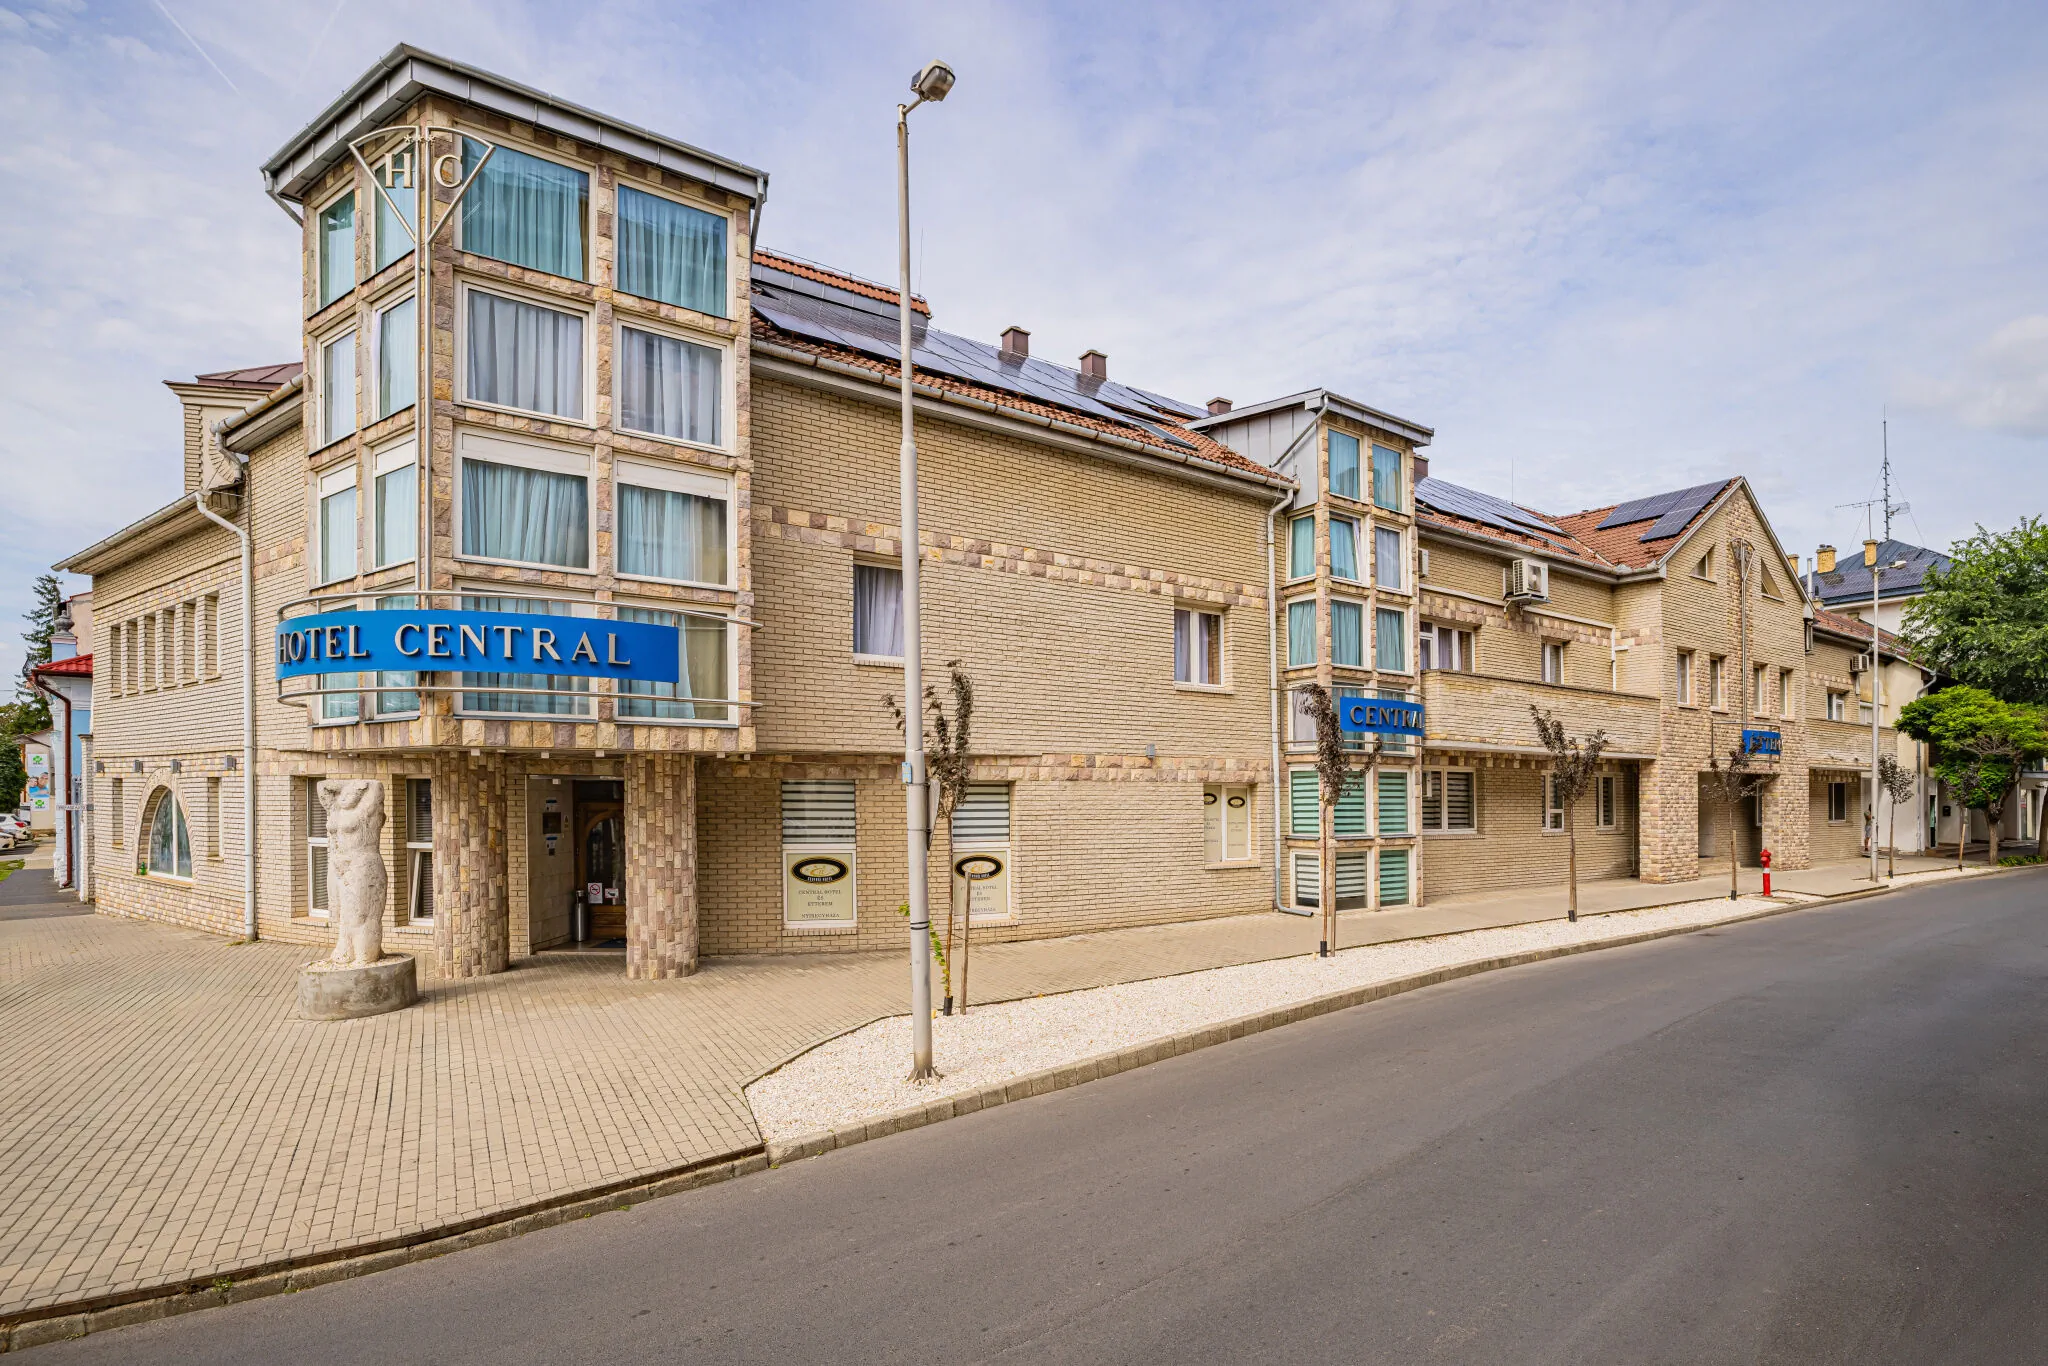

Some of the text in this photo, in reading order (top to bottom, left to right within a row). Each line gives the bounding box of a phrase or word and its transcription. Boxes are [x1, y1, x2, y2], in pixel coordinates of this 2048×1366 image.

[385, 153, 462, 188] H C
[278, 623, 631, 665] HOTEL CENTRAL
[1350, 705, 1425, 729] CENTRAL
